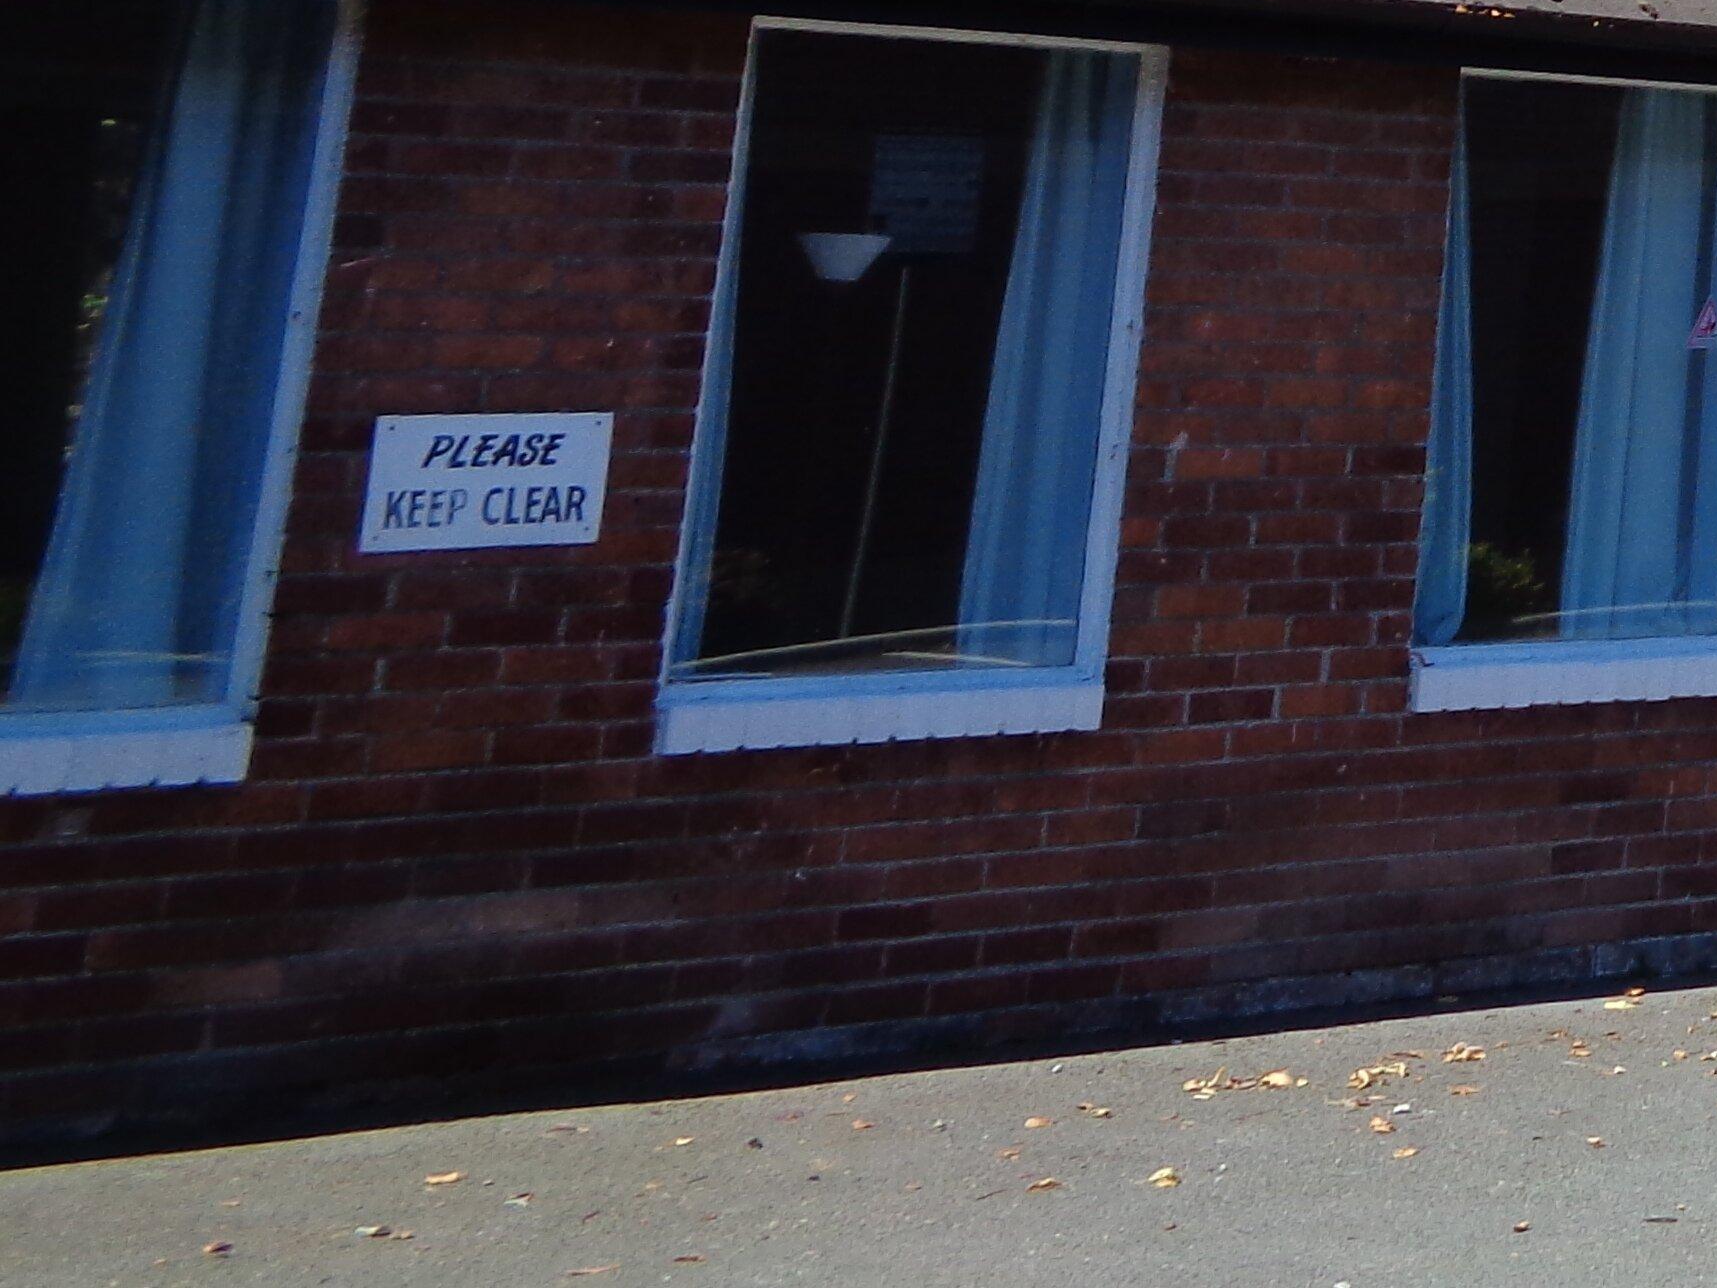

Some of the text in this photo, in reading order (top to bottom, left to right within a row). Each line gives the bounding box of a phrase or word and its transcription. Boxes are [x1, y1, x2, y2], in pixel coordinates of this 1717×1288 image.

[421, 432, 567, 469] PLEASE
[383, 485, 587, 530] KEEP CLEAR
